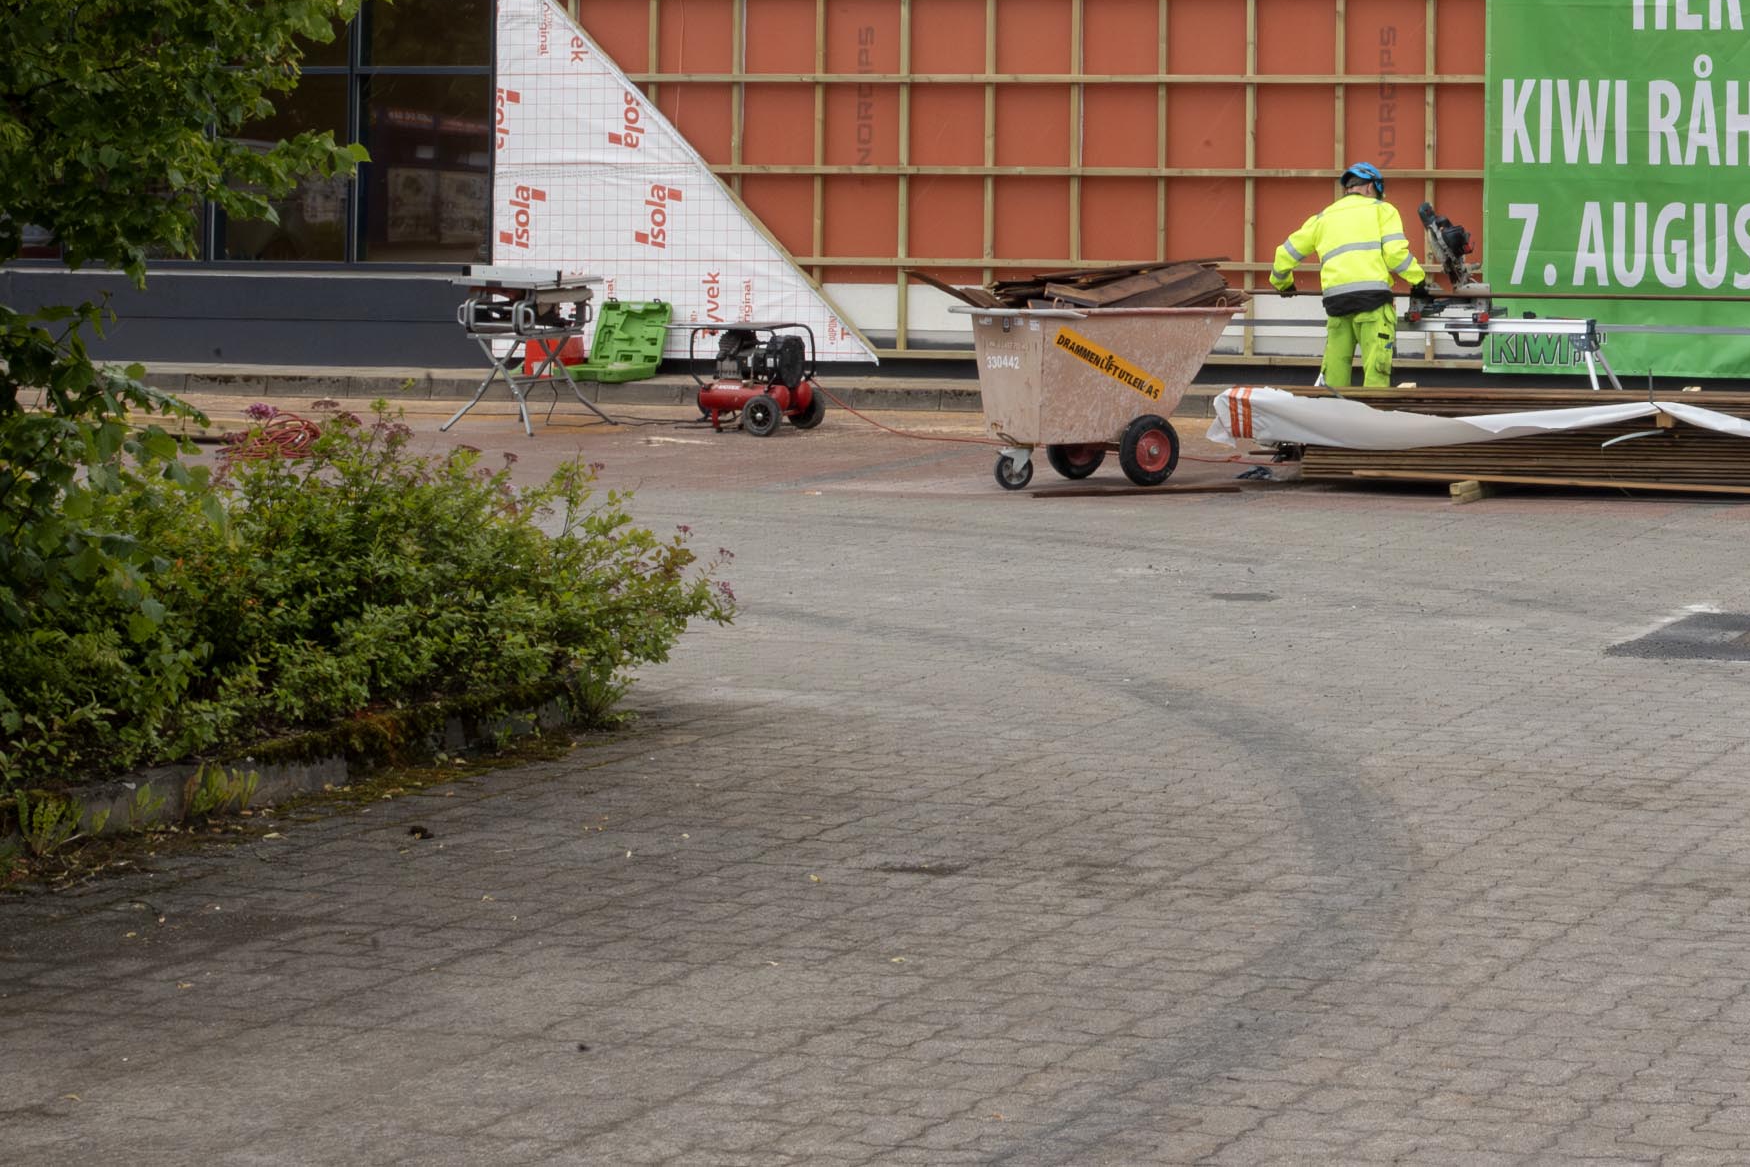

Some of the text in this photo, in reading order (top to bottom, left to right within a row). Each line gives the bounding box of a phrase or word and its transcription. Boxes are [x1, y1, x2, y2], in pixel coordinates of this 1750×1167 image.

[1500, 78, 1628, 165] KIWI
[509, 183, 531, 249] isola
[644, 183, 667, 249] isola
[1508, 203, 1556, 287] 7.
[986, 354, 1020, 370] 330442
[1056, 334, 1100, 367] DRAMMEN
[1490, 332, 1570, 366] KIWI
